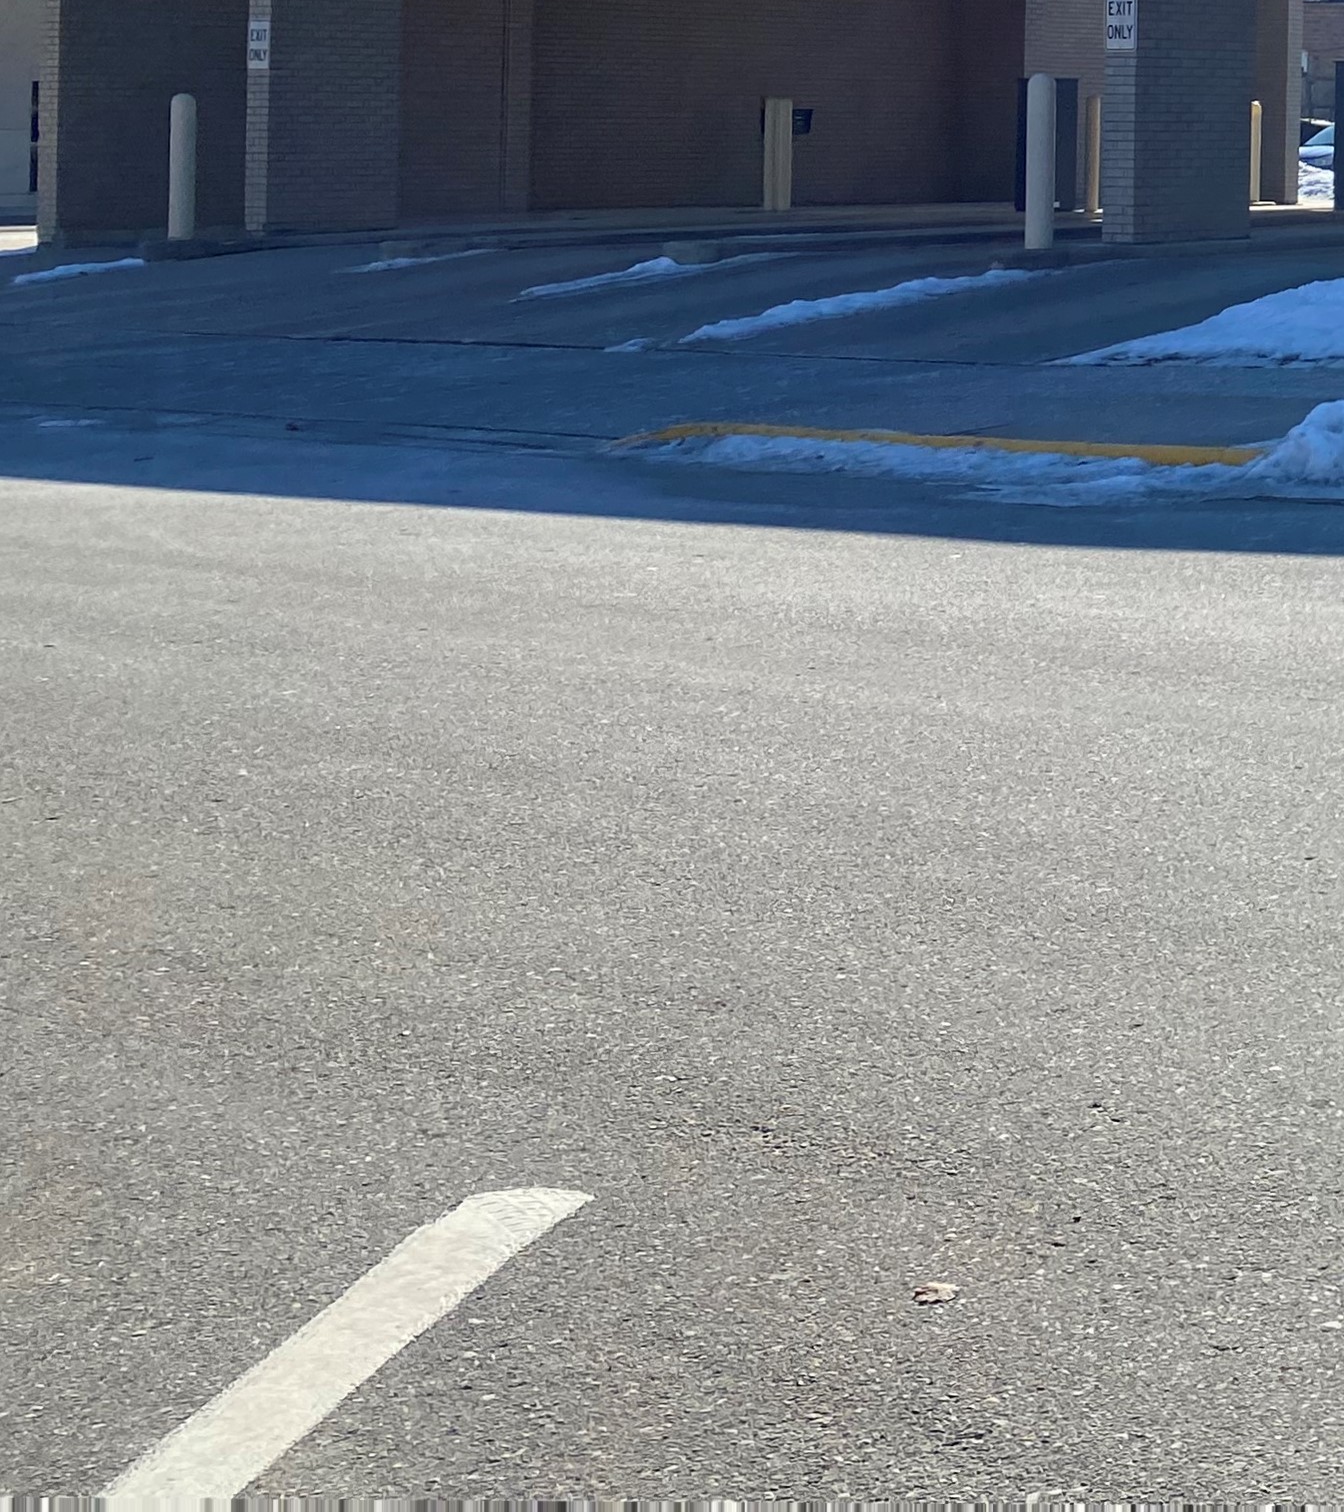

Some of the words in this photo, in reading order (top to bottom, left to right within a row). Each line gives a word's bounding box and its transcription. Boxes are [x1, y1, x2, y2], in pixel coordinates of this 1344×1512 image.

[1108, 0, 1133, 16] EXIT
[250, 28, 267, 42] EXIT
[1107, 24, 1133, 40] ONLY
[249, 48, 267, 62] ONLY
